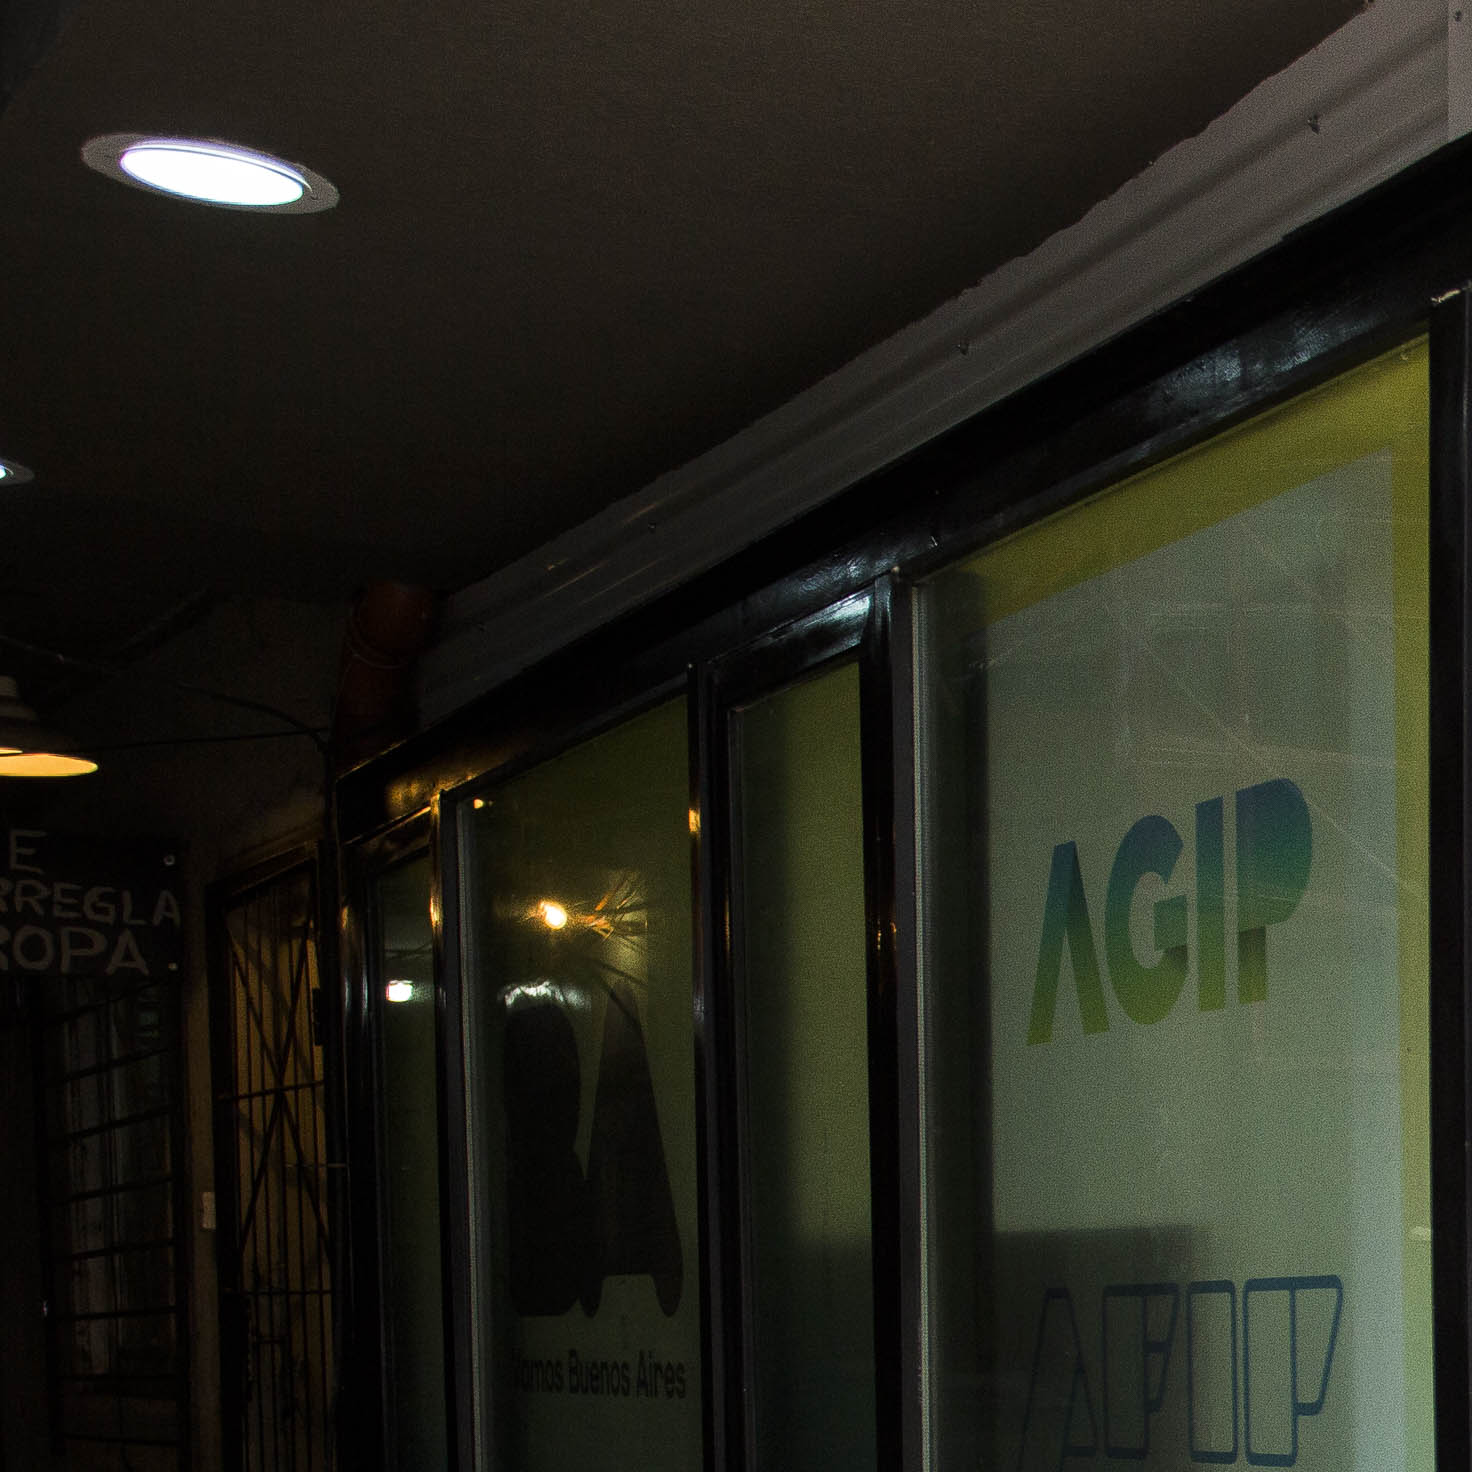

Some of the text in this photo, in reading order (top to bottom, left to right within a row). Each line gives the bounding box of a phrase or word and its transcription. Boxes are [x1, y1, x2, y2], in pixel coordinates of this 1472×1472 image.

[1026, 778, 1313, 1047] AGIP
[568, 1349, 631, 1397] Buenos
[636, 1350, 686, 1399] Aires
